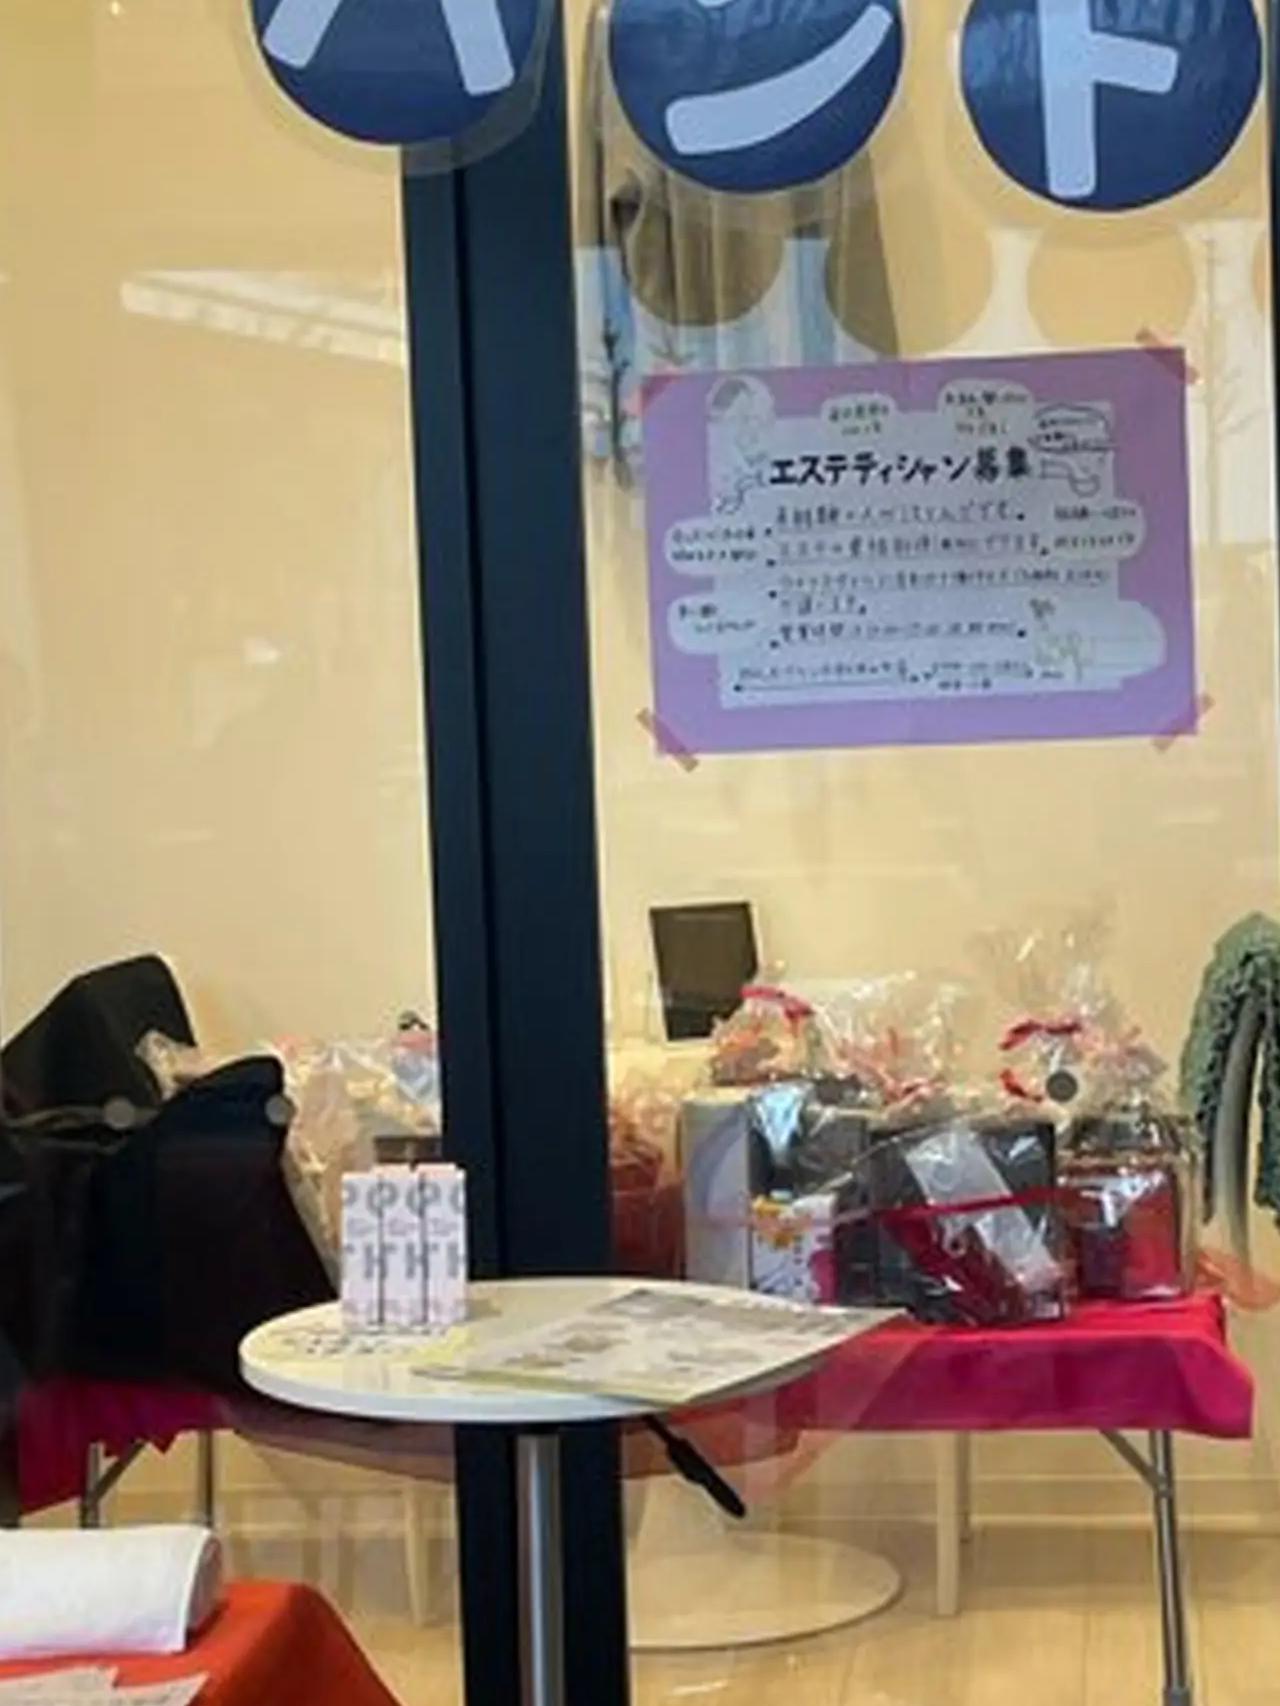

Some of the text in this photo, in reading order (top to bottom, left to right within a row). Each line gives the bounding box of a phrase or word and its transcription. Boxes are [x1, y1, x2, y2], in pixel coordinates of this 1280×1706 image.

[769, 445, 1033, 487] エステティシャン募集
